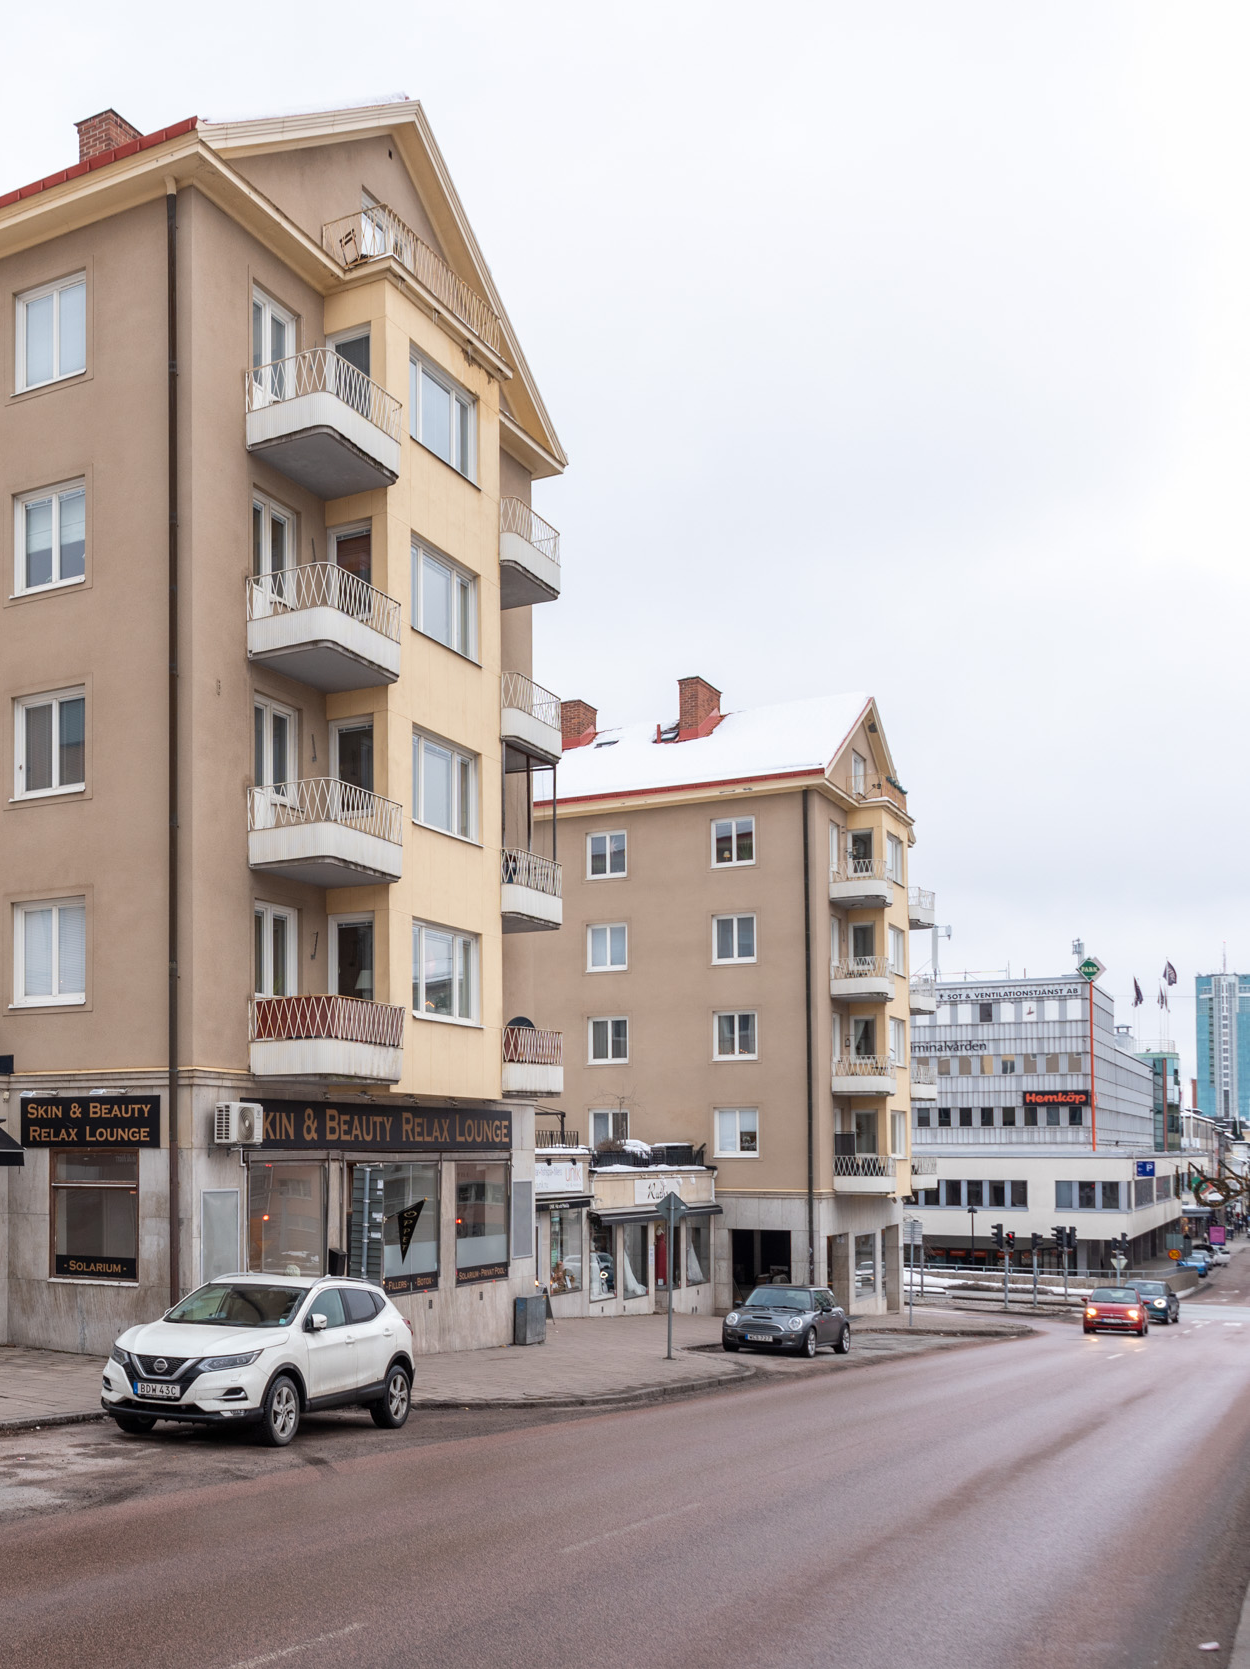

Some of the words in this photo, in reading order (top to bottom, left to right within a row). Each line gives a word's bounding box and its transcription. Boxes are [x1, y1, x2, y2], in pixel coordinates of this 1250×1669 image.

[947, 993, 962, 1001] SOT
[974, 988, 1064, 999] VENTILATIONSTJÄNST
[1066, 987, 1079, 995] AB
[910, 1041, 987, 1053] iminalvården
[1025, 1092, 1086, 1104] Hemköp
[27, 1103, 62, 1119] SKIN
[70, 1103, 82, 1118] &
[90, 1103, 151, 1118] BEAUTY
[263, 1111, 295, 1140] KIN
[303, 1108, 318, 1141] &
[325, 1108, 394, 1142] BEAUTY
[402, 1112, 450, 1142] RELAX
[455, 1114, 510, 1143] LOUNGE
[30, 1126, 78, 1141] RELAX
[86, 1126, 150, 1141] LOUNGE
[1146, 1164, 1153, 1172] P
[159, 1385, 176, 1396] 43C
